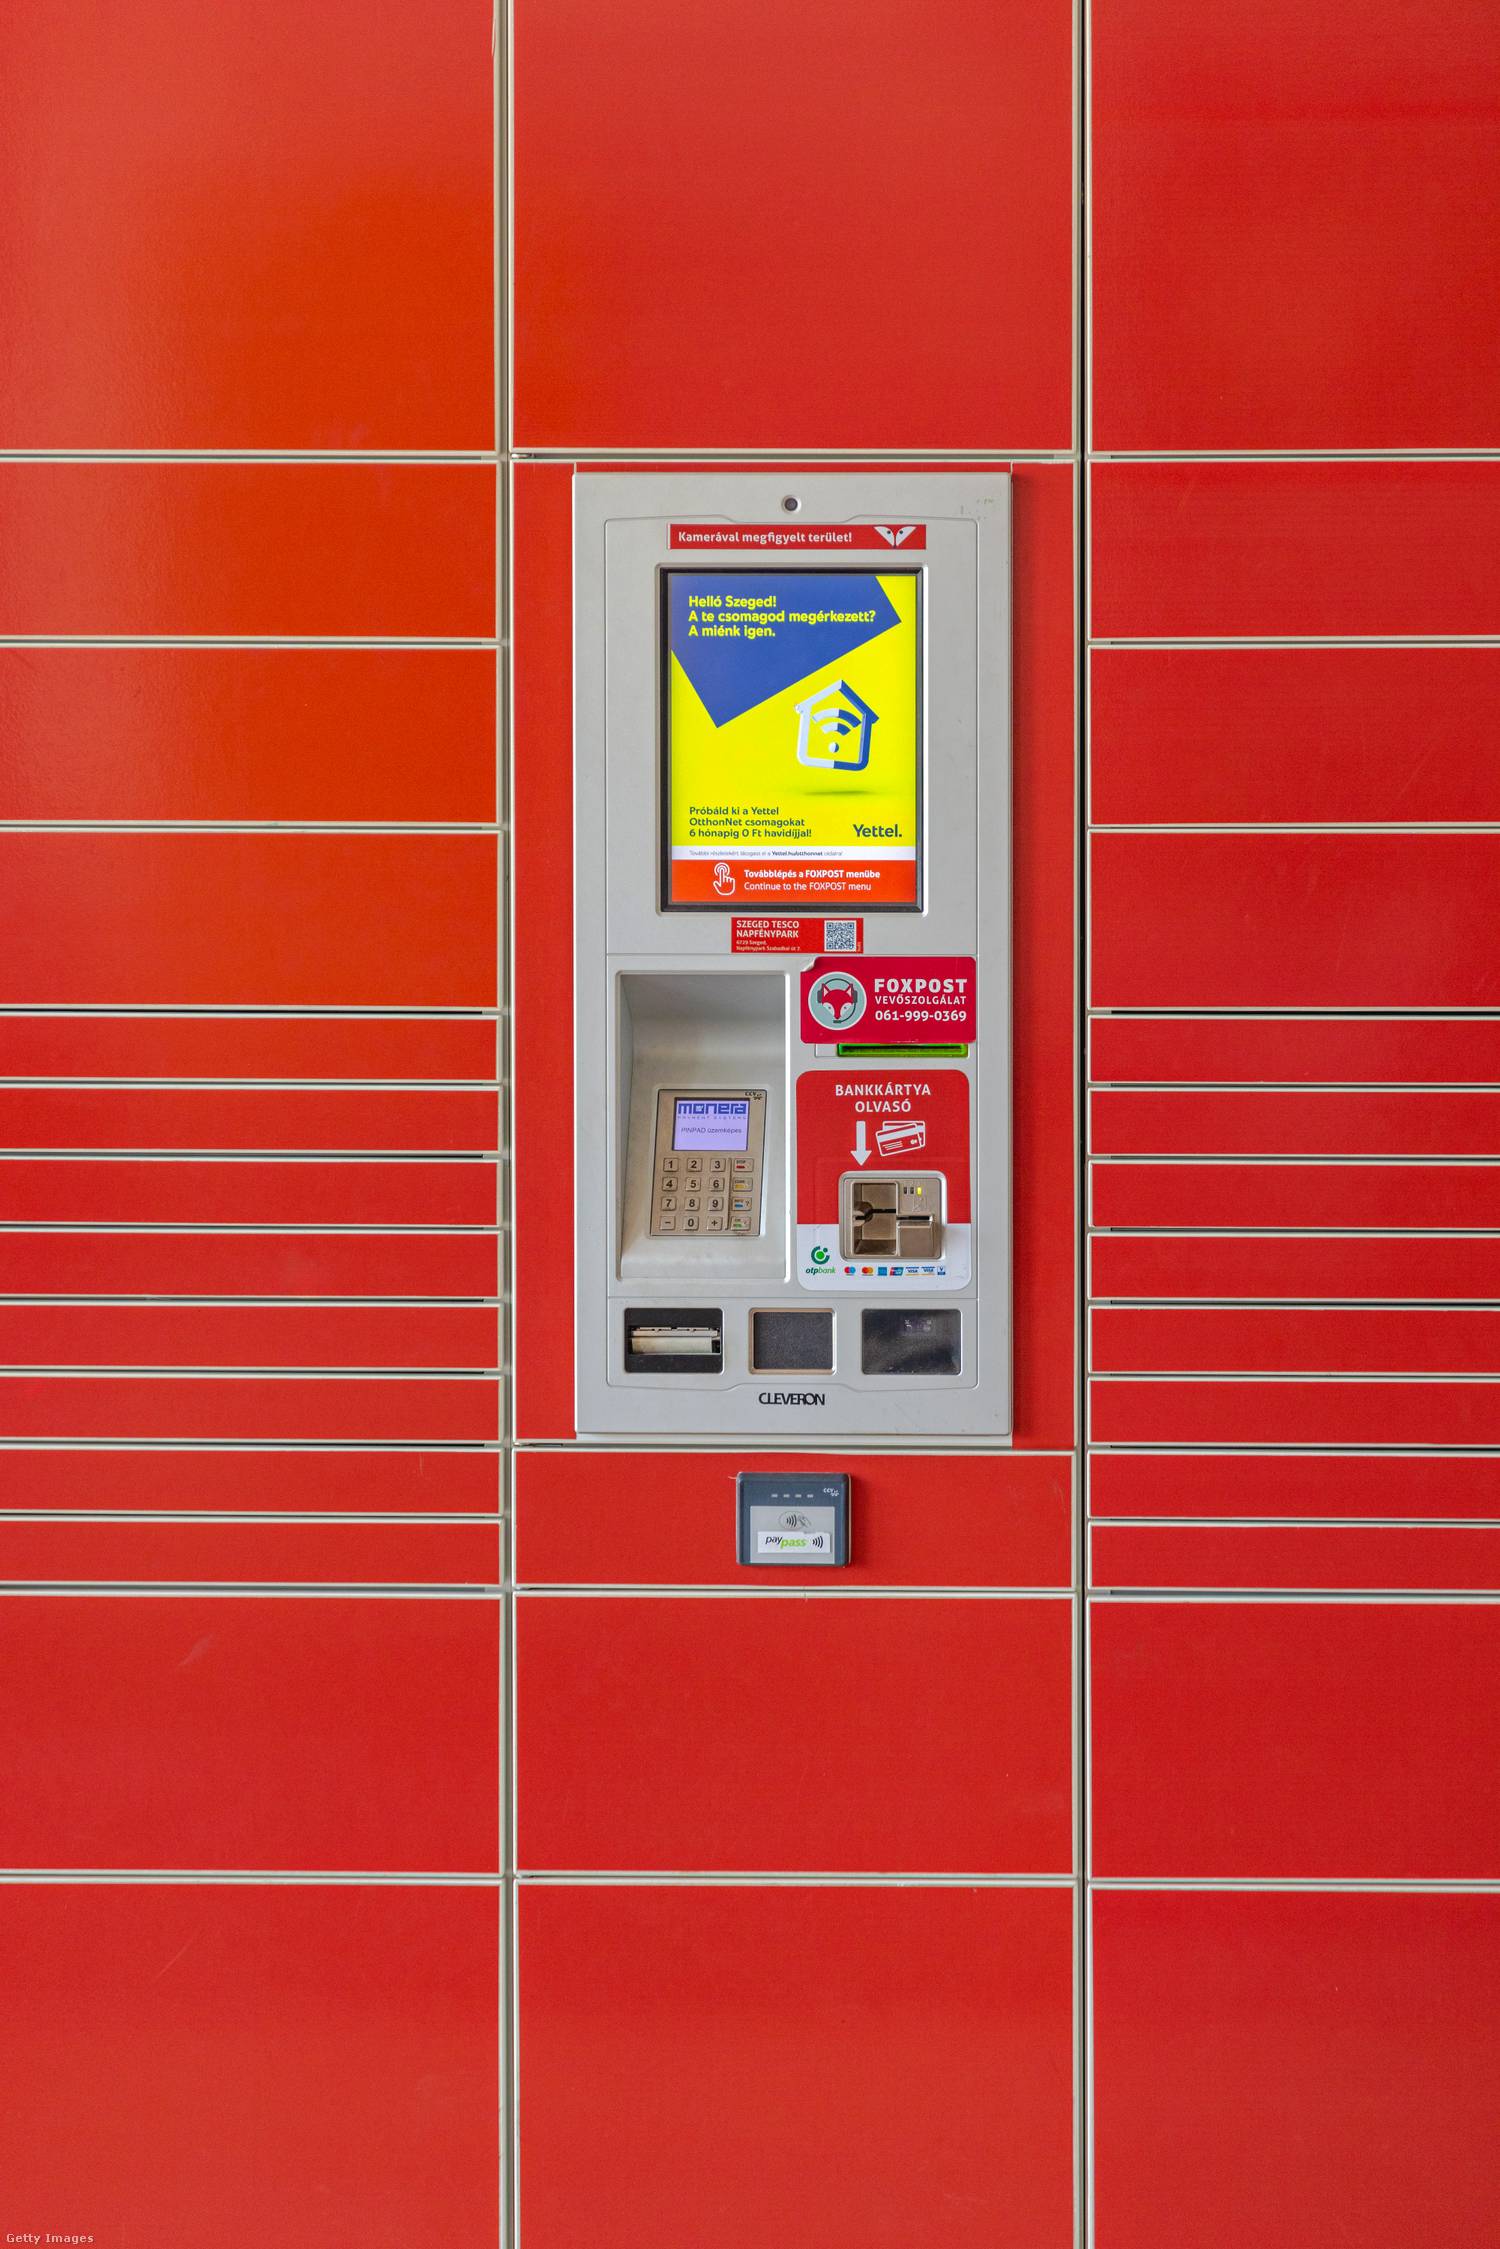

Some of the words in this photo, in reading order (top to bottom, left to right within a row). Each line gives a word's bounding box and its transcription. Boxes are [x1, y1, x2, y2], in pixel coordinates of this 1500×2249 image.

[678, 531, 740, 543] Kamerával
[741, 531, 806, 545] megfigyelt
[808, 531, 853, 543] terület!
[688, 595, 722, 608] Helló
[725, 595, 777, 610] Szeged!
[688, 611, 698, 622] A
[701, 611, 715, 622] te
[718, 610, 785, 625] csomagod
[789, 610, 876, 625] megérkezett?
[688, 626, 698, 636] A
[702, 625, 741, 636] miénk
[743, 625, 776, 640] igen.
[689, 806, 729, 816] Próbáld
[732, 806, 740, 816] ki
[751, 806, 779, 816] Yettel
[689, 818, 742, 826] OtthonNet
[745, 818, 805, 828] csomagokat
[689, 829, 696, 838] 6
[698, 828, 740, 839] hónapig
[742, 829, 750, 838] 0
[752, 829, 762, 838] Ft
[764, 828, 812, 839] havidíjjal!
[853, 824, 902, 838] Yettel.
[744, 869, 797, 880] Továbblépés
[806, 870, 844, 878] FOXPOST
[846, 869, 880, 878] menübe
[744, 882, 781, 890] Continue
[782, 882, 791, 890] to
[793, 882, 807, 890] the
[809, 882, 846, 890] FOXPOST
[736, 920, 770, 928] SZEGED
[772, 920, 800, 929] TESCO
[736, 929, 799, 938] NAPFÉNYPARK
[874, 978, 968, 993] FOXPOST
[875, 994, 967, 1005] VEVŐSZOLGÁLAT
[875, 1010, 967, 1022] 061-999-0369
[835, 1082, 932, 1096] BANKKÁRTYA
[678, 1103, 747, 1114] monera
[854, 1098, 912, 1113] OLVASÓ
[668, 1160, 674, 1168] 1
[690, 1160, 697, 1168] 2
[714, 1160, 720, 1168] 3
[666, 1180, 673, 1188] 4
[690, 1180, 696, 1188] 5
[713, 1180, 719, 1188] 6
[666, 1199, 672, 1208] 7
[689, 1199, 695, 1208] 8
[712, 1200, 718, 1208] 9
[688, 1218, 694, 1227] 0
[806, 1266, 836, 1275] otpbank
[758, 1392, 826, 1406] CLEVERON
[765, 1536, 808, 1549] paypass
